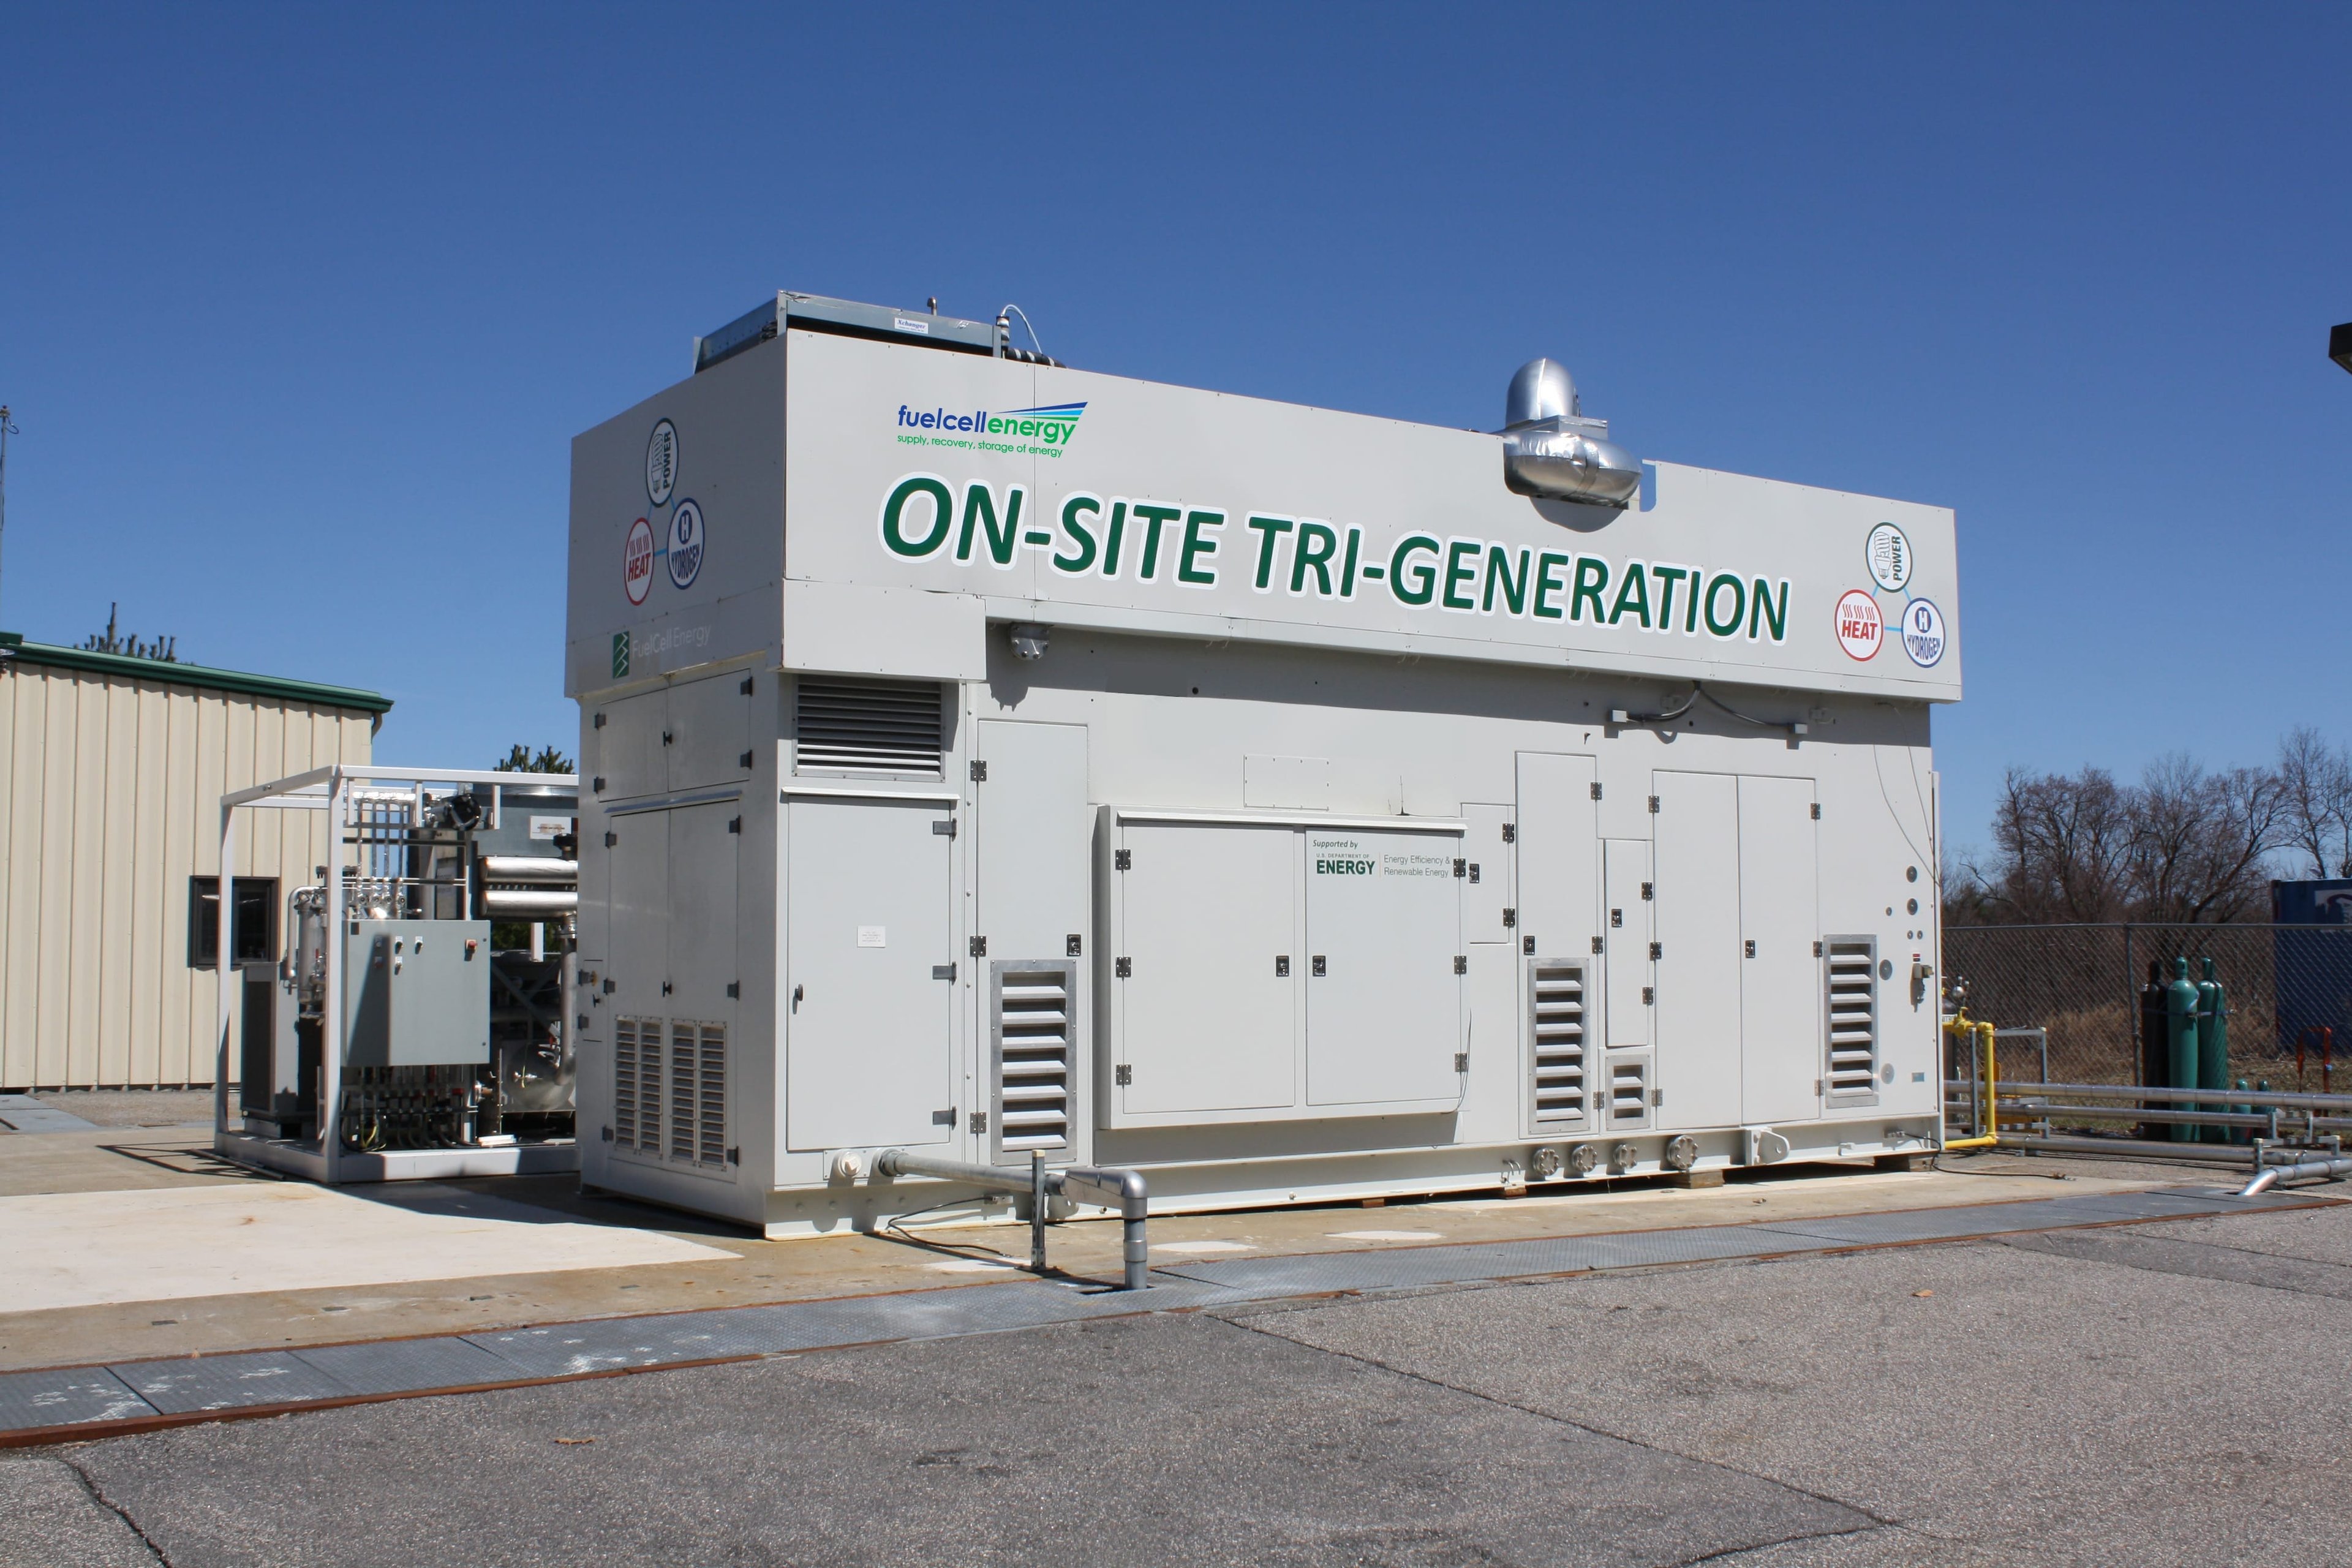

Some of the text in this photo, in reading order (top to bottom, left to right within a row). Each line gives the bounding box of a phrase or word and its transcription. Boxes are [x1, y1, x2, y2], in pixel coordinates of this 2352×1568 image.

[897, 434, 1063, 458] supply, recovery, storage of energy
[628, 552, 651, 582] HEAT
[671, 544, 700, 579] HYDROGEN
[882, 477, 1789, 641] ON-SITE TRI-GENERATION
[1891, 536, 1902, 581] POWER
[1842, 620, 1878, 641] HEAT
[1907, 634, 1940, 660] HYDROGEN
[1313, 839, 1359, 850] Supported by
[1316, 859, 1376, 875] ENERGY
[1384, 854, 1408, 865] Energy
[1411, 855, 1443, 865] Efficiency
[1384, 867, 1449, 878] Renewable Energy
